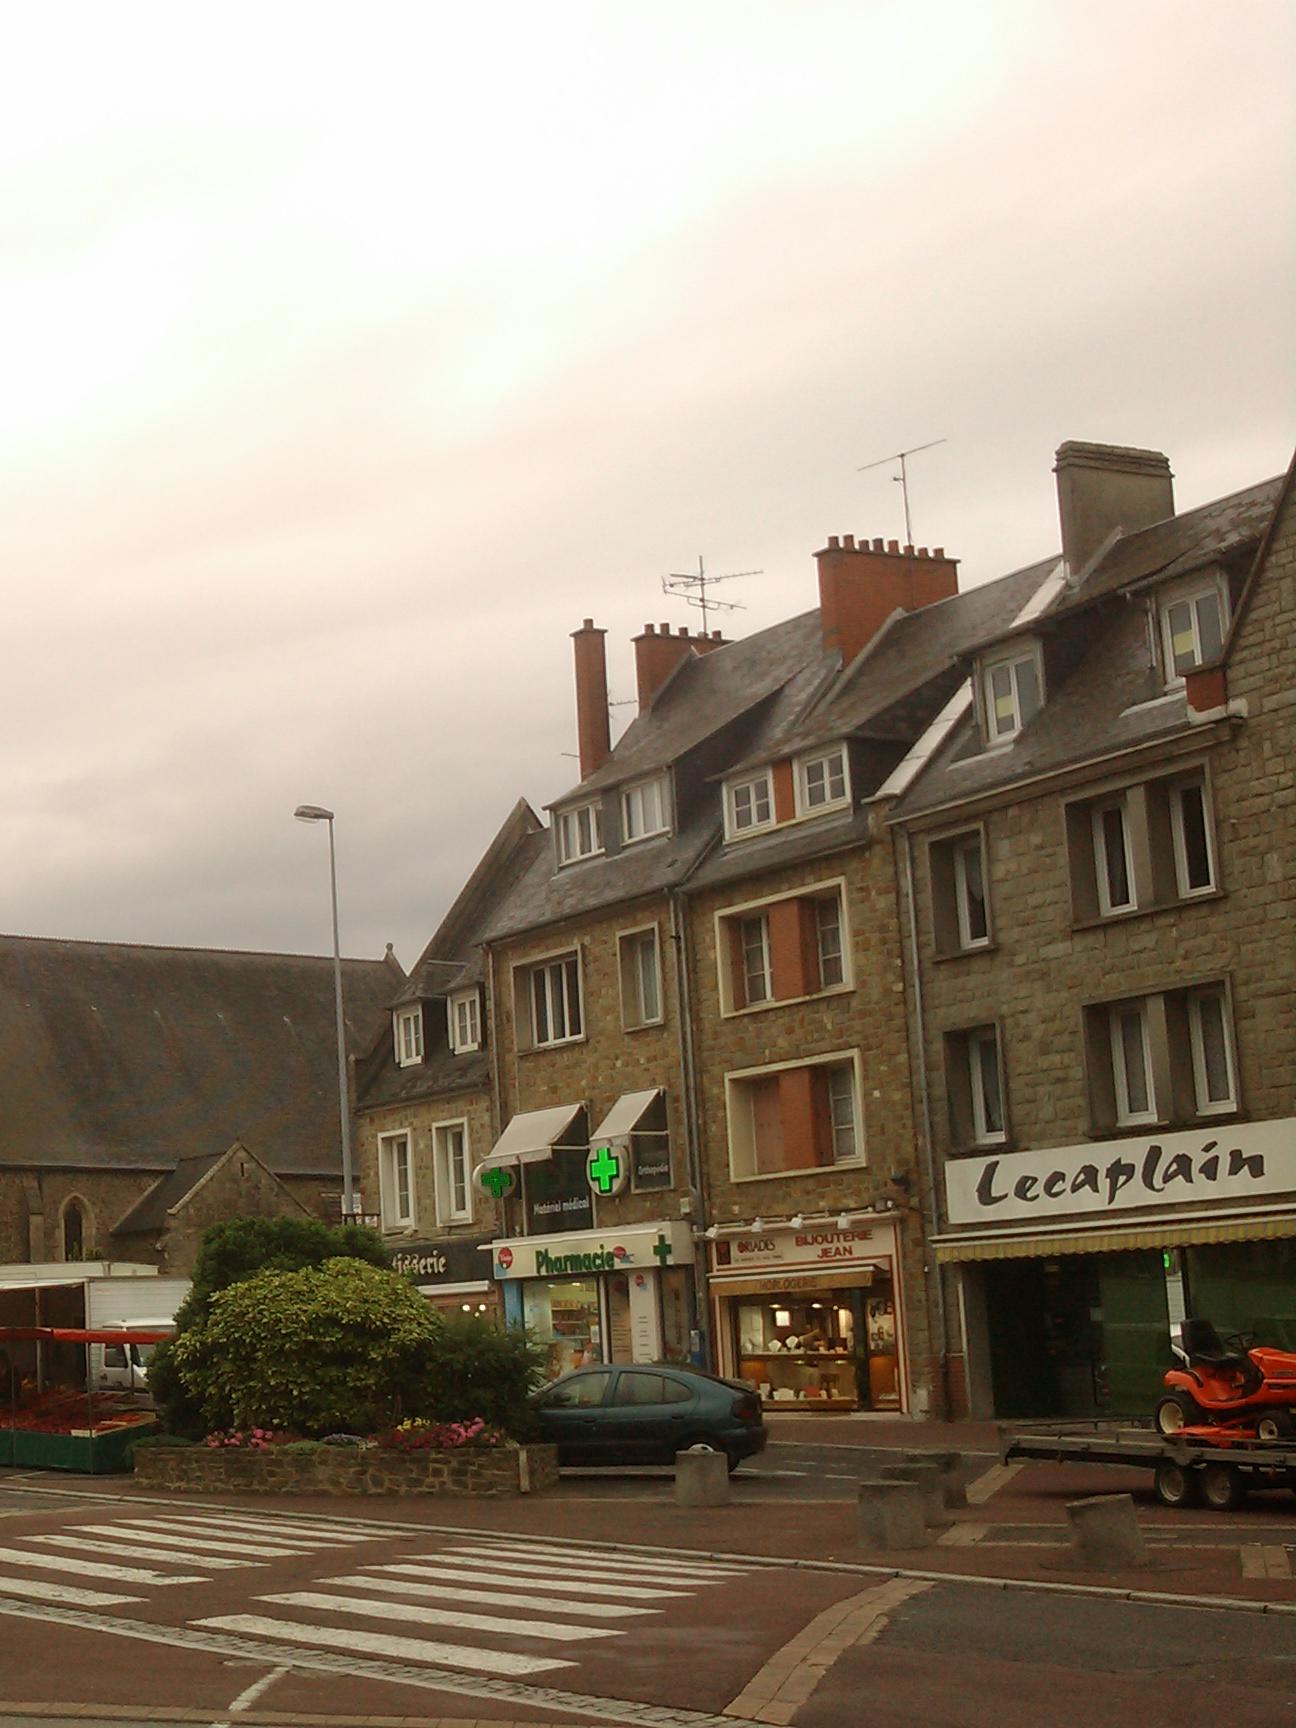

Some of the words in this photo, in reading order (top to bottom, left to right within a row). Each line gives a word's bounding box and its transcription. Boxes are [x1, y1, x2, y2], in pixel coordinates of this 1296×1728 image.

[975, 1140, 1266, 1207] Lecaplain
[795, 1229, 873, 1247] BIJOUTERIE
[391, 1249, 448, 1276] tisserie
[535, 1243, 615, 1275] Pharmacie
[817, 1246, 853, 1259] JEAN
